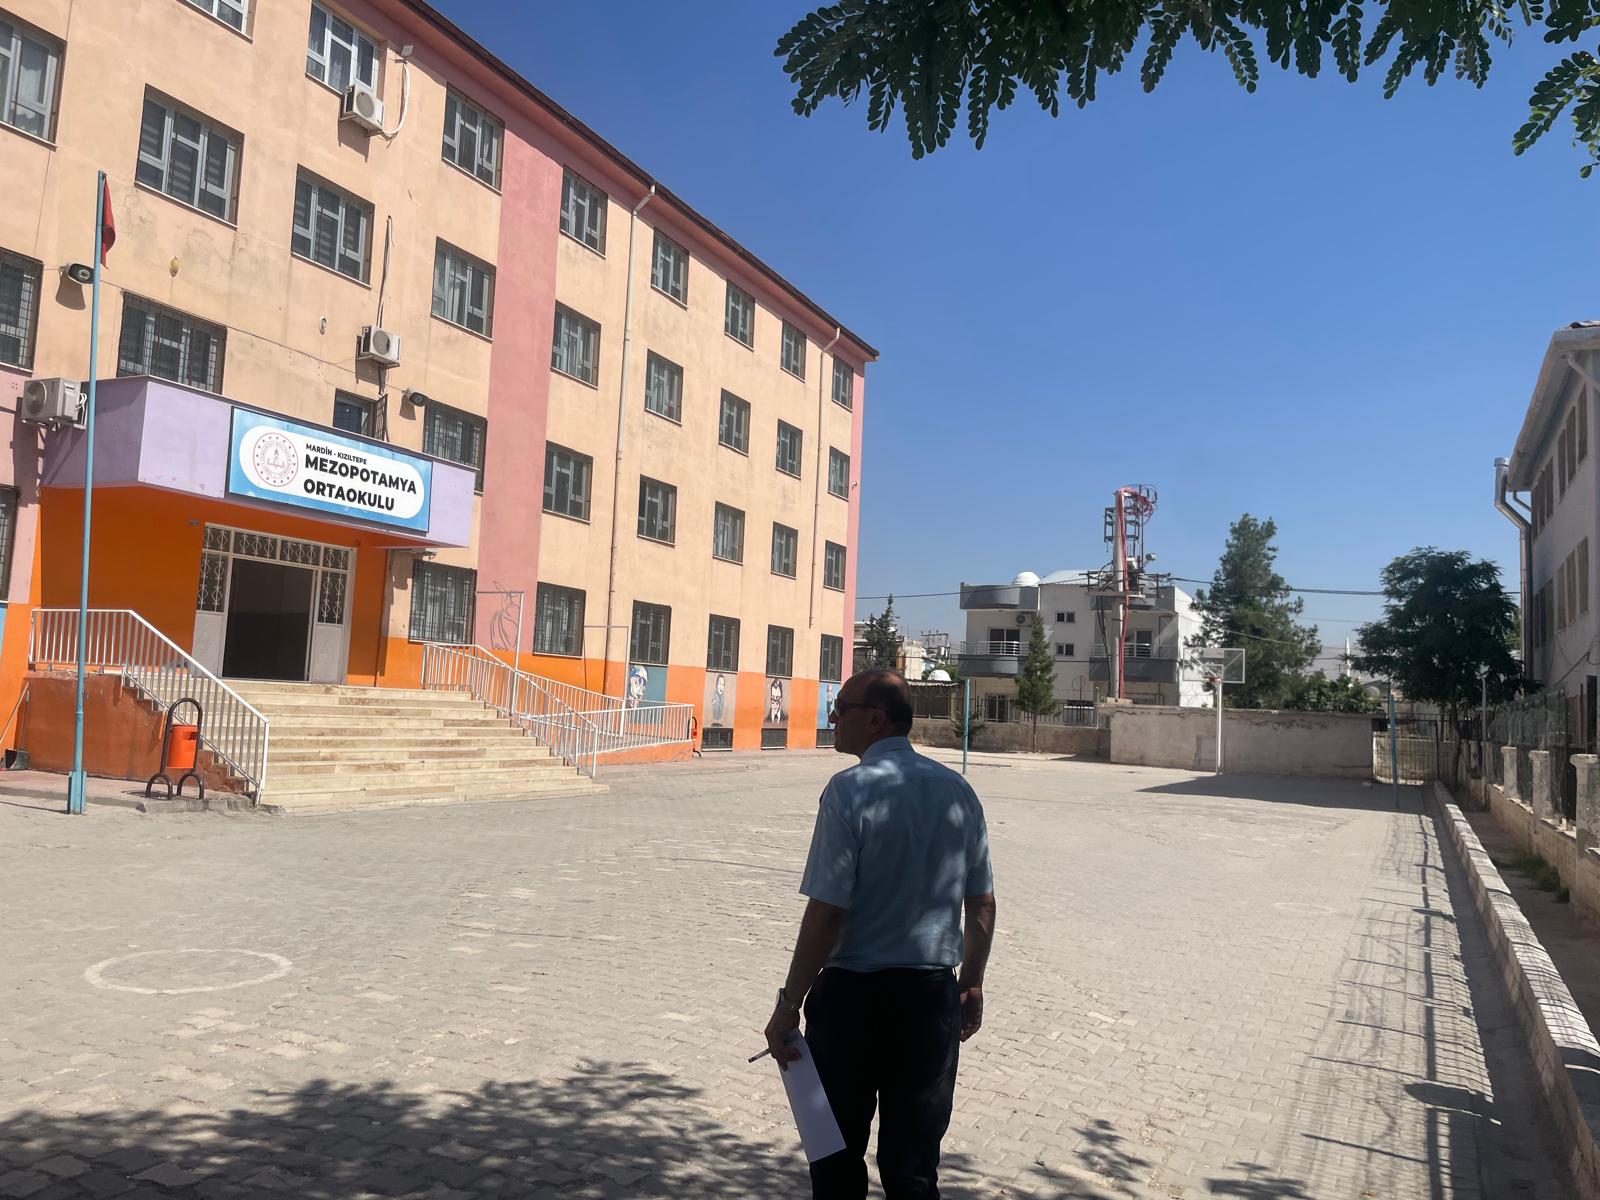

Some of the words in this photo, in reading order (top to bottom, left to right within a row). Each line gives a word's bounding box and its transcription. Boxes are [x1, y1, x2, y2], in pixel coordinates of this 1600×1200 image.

[305, 443, 333, 456] MARDİN
[337, 451, 368, 465] KIZILTEPE
[304, 454, 417, 495] MEZOPOTAMYA
[303, 478, 395, 511] ORTAOKULU
